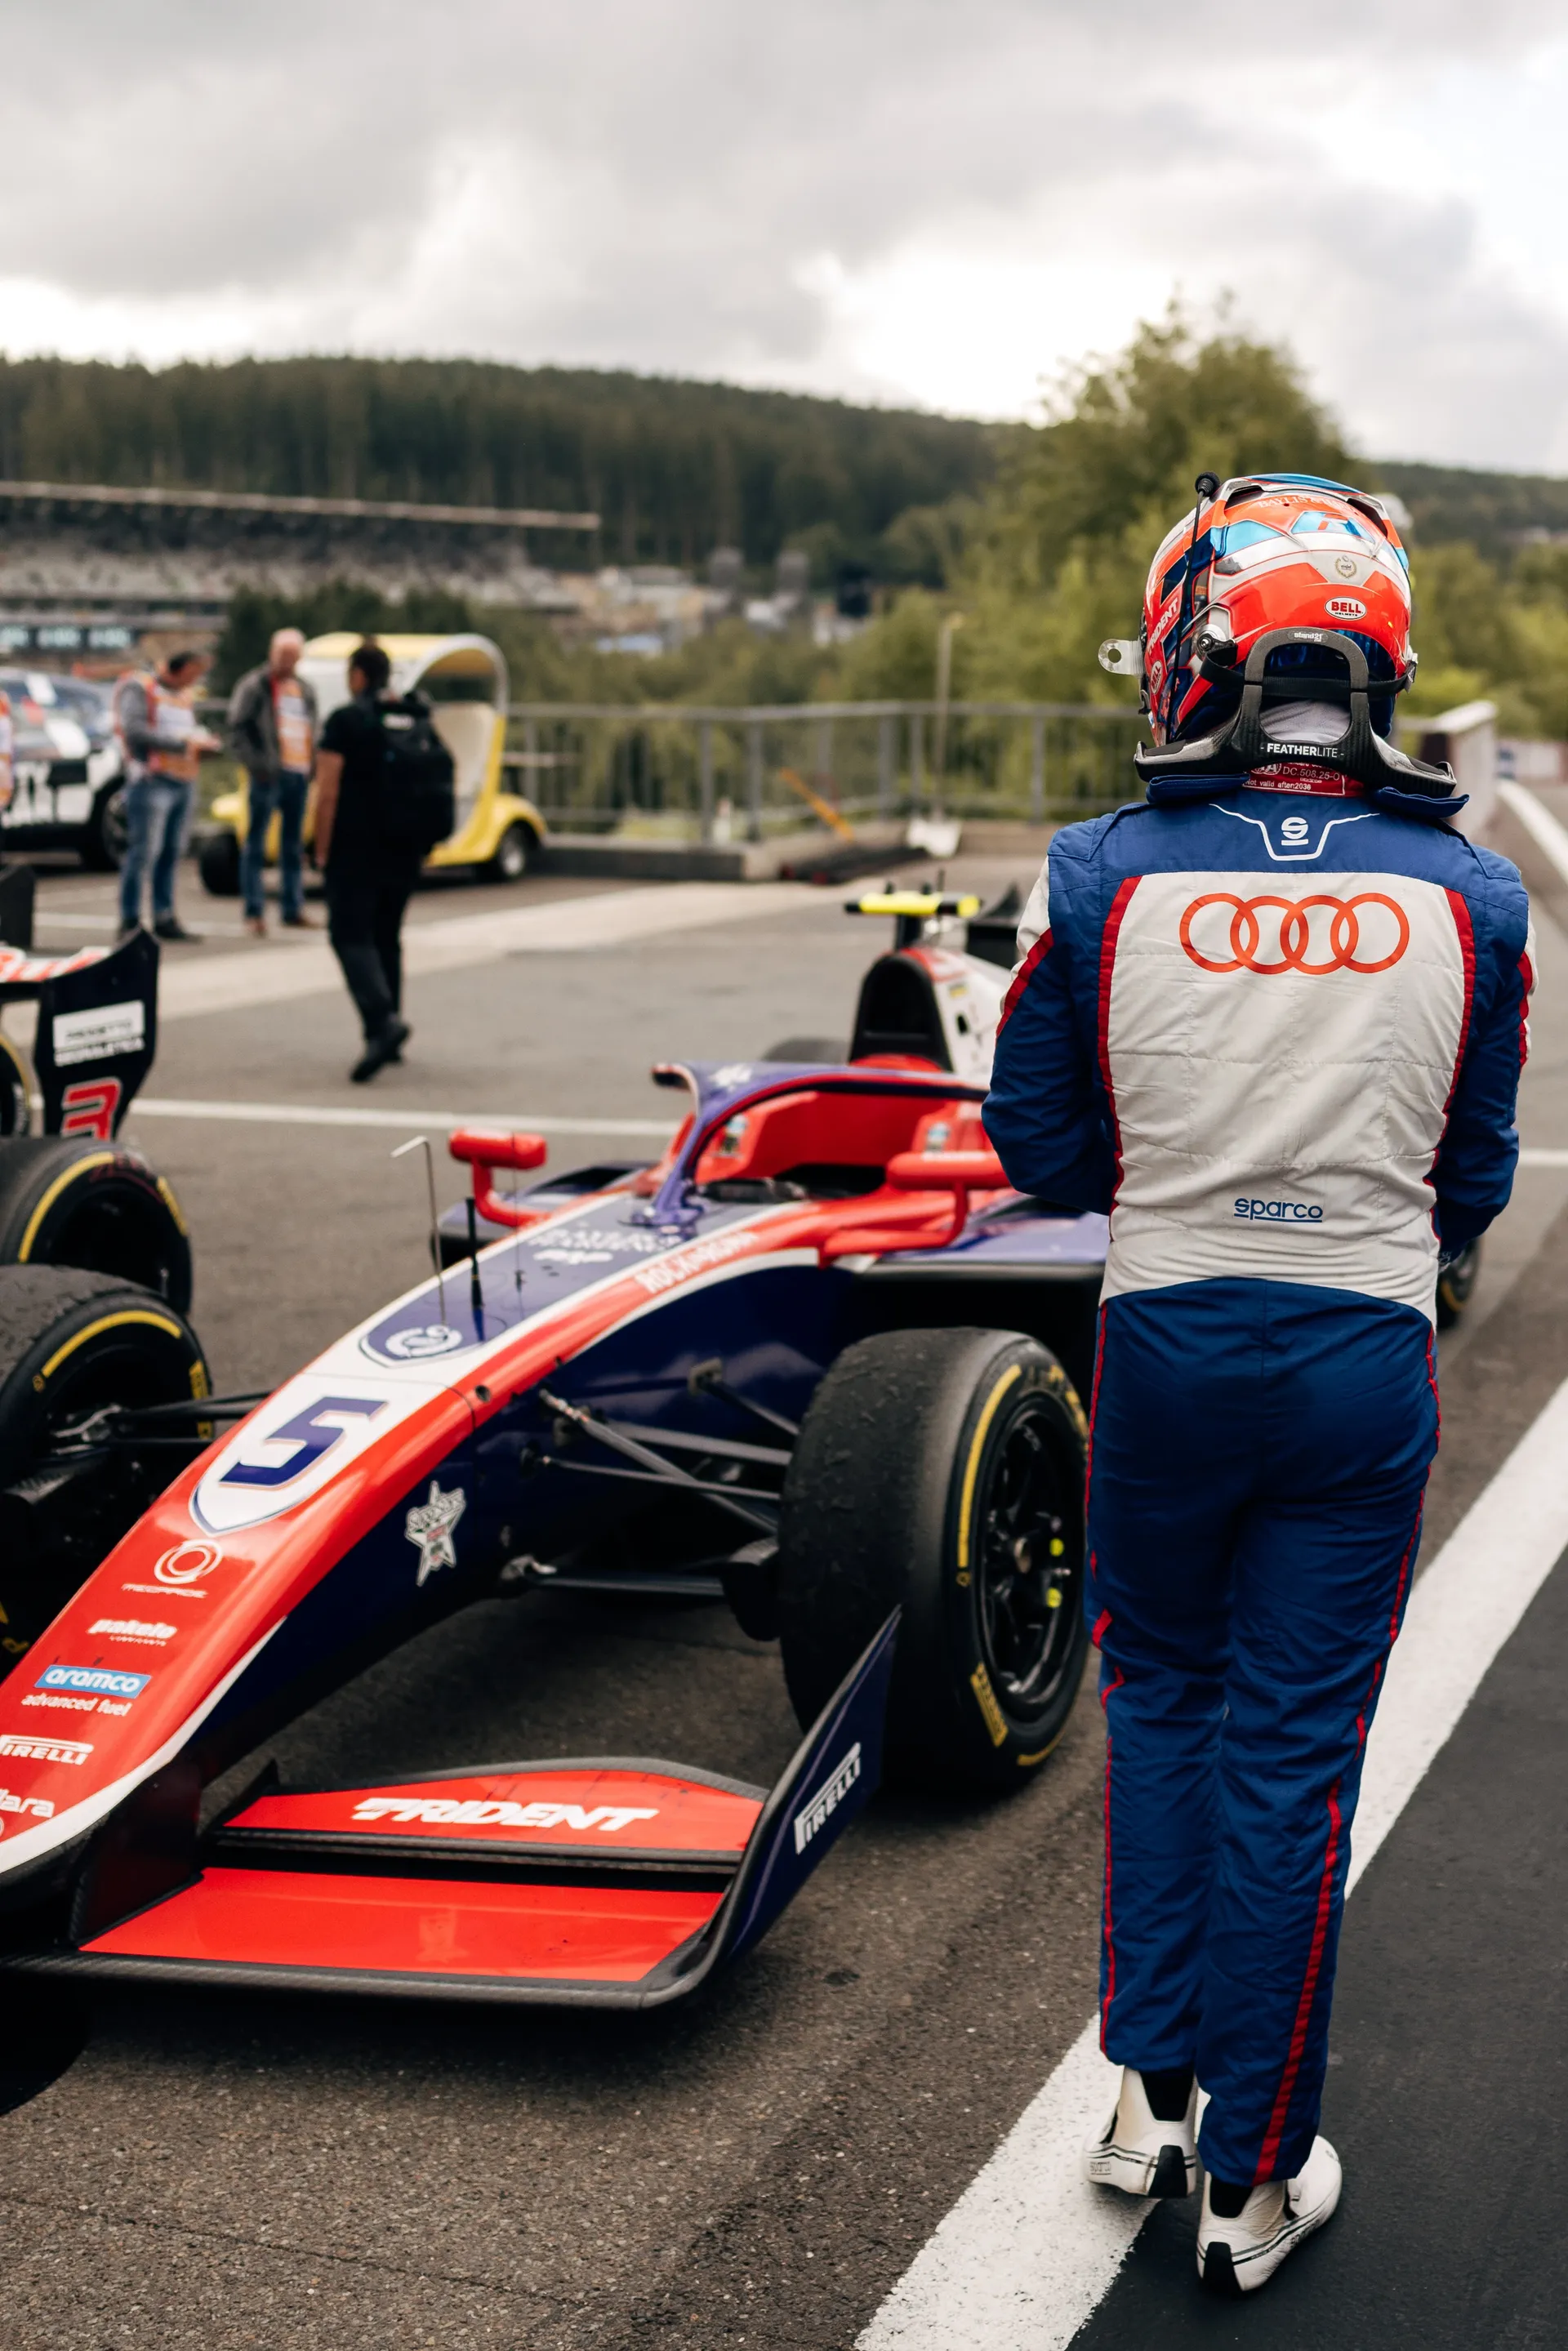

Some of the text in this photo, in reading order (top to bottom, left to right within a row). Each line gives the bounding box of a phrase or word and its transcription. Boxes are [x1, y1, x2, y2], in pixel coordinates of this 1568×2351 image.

[1258, 496, 1307, 508] BAYLIS
[1331, 601, 1361, 614] BELL
[1147, 599, 1178, 653] TRIDENT
[1267, 742, 1338, 758] FEATHERLITE
[1234, 1198, 1323, 1222] sparco
[218, 1396, 389, 1491] 5
[45, 1669, 140, 1693] aramco
[21, 1693, 133, 1716] advanced fuel
[794, 1742, 862, 1855] PIRELLI
[350, 1797, 660, 1831] TRIDENT
